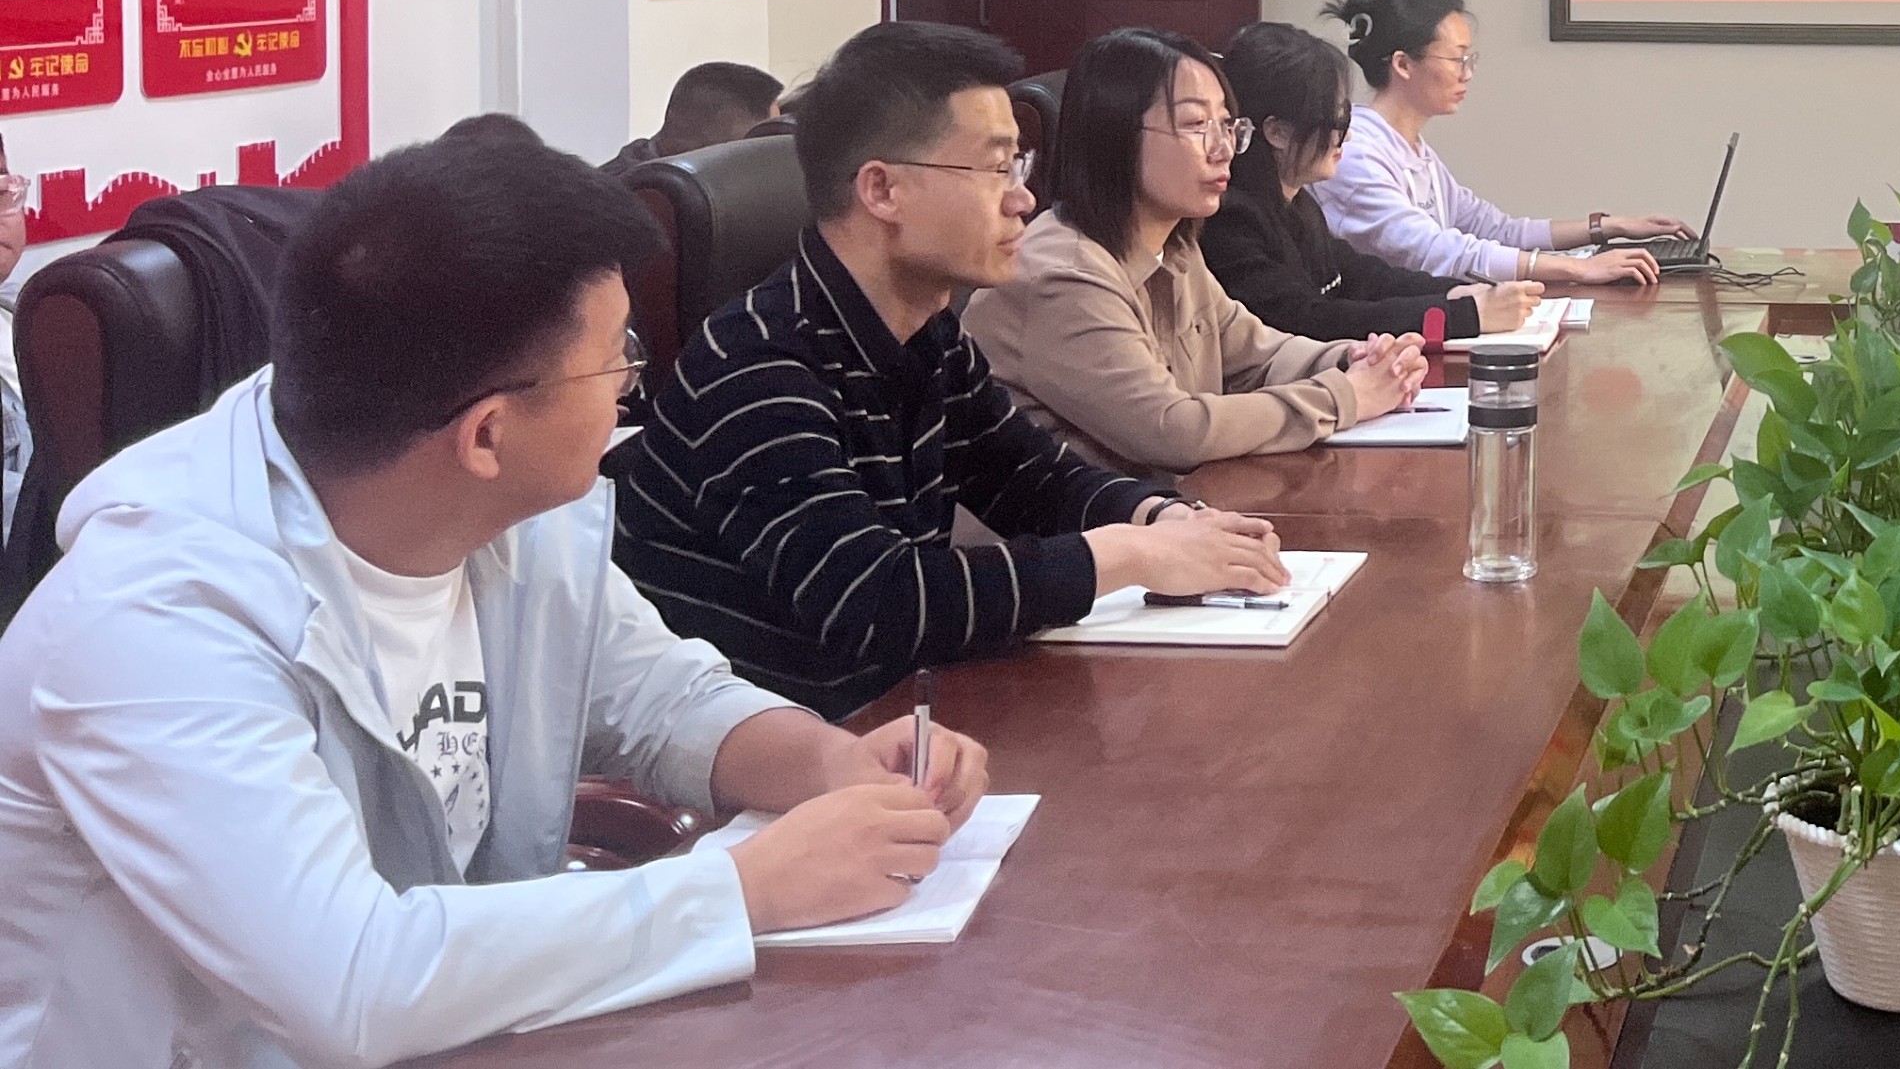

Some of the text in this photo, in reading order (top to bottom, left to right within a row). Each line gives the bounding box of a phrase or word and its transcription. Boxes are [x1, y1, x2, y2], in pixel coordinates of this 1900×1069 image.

[256, 30, 300, 51] 牢记使命
[30, 53, 89, 77] 牢记使命
[206, 63, 277, 82] 全心全意为人民服务
